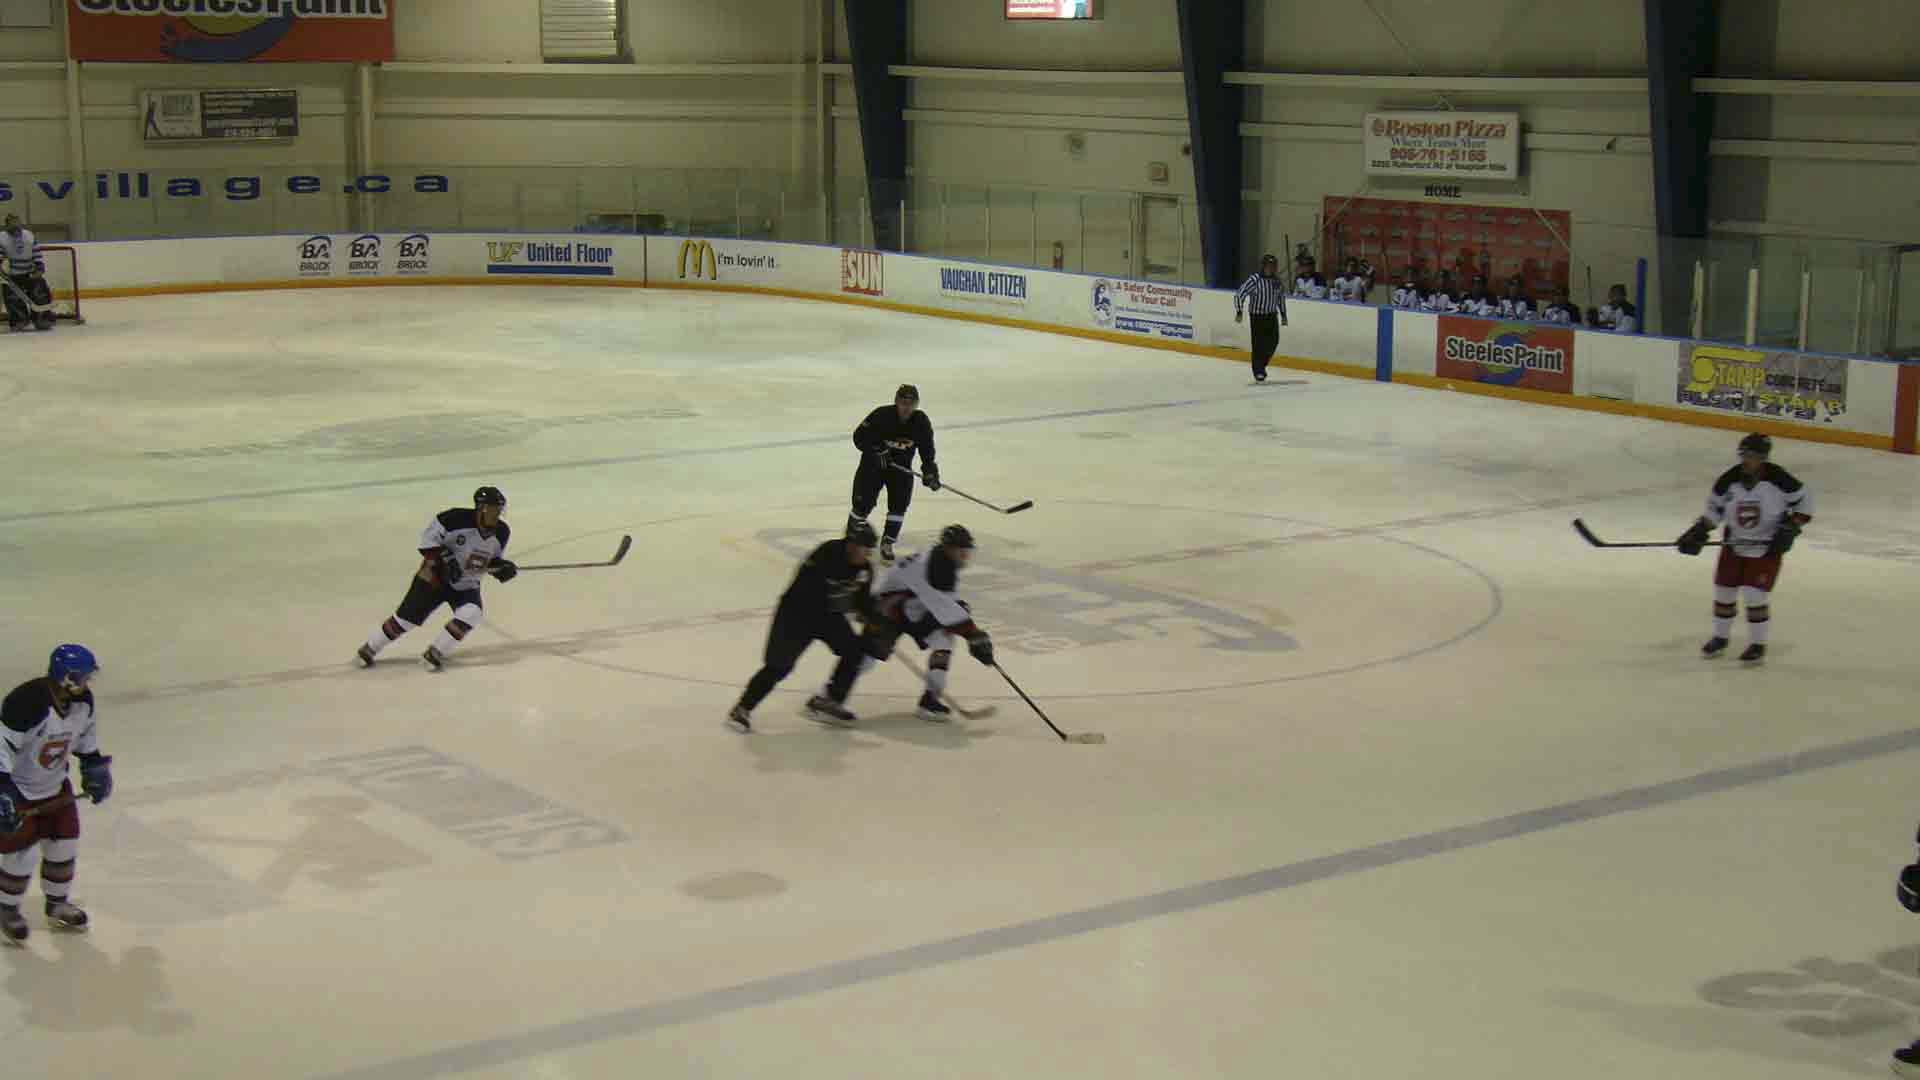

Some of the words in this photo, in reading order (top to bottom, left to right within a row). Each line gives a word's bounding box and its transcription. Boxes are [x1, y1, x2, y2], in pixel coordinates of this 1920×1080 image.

[1385, 119, 1450, 137] Boston
[1456, 119, 1506, 137] Pizza
[1424, 183, 1461, 198] HOME
[527, 242, 572, 263] United
[576, 243, 613, 263] Floor
[737, 253, 766, 267] lovin'
[847, 251, 881, 291] SUN
[940, 267, 986, 294] VAUGHAN
[988, 272, 1027, 299] CITIZEN
[1446, 337, 1564, 372] SteelesPaint
